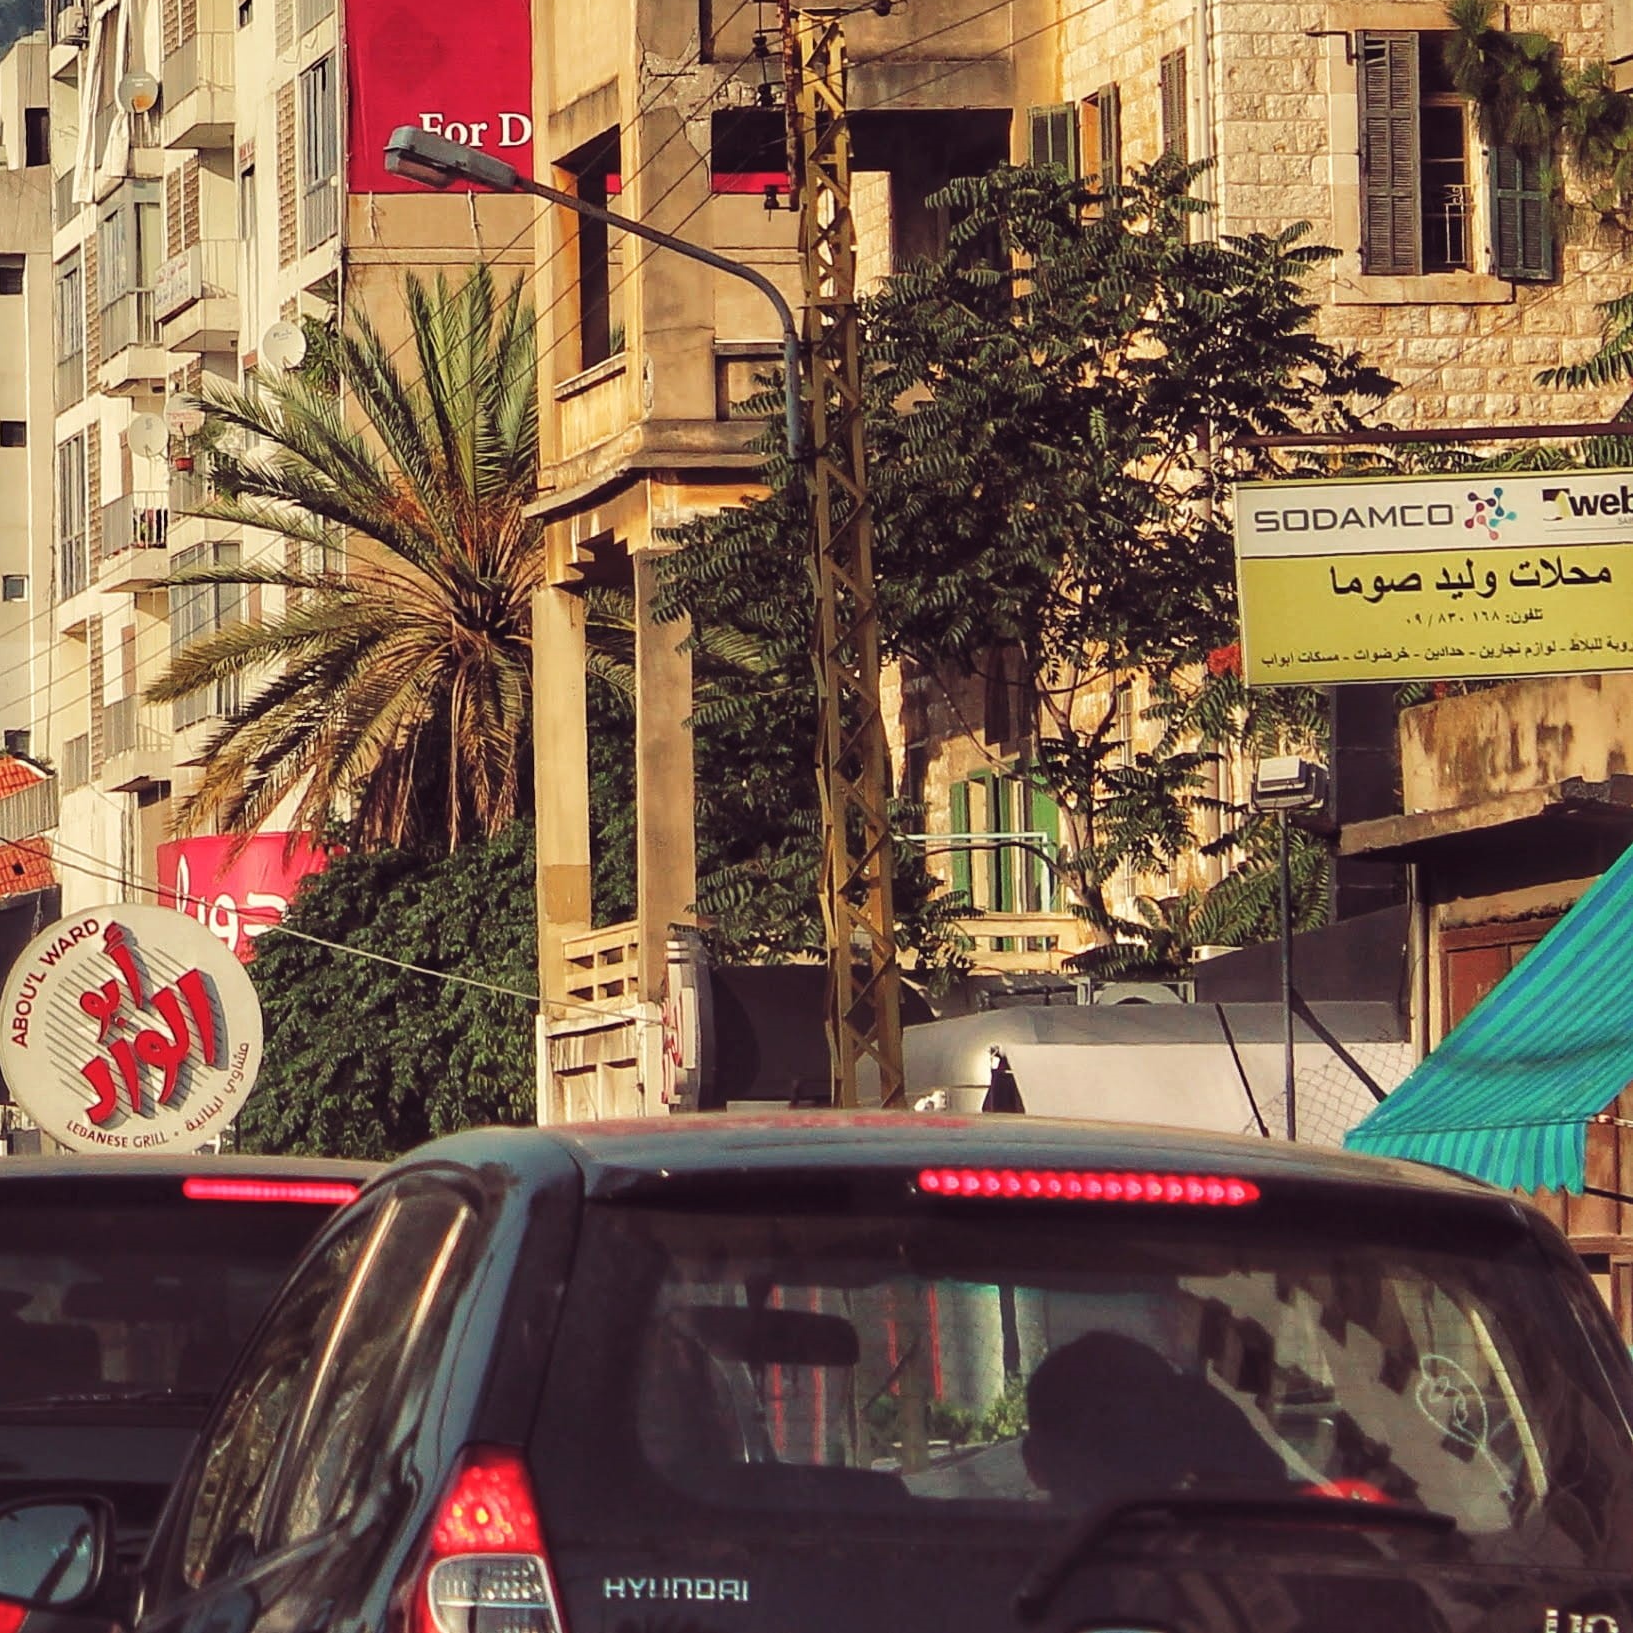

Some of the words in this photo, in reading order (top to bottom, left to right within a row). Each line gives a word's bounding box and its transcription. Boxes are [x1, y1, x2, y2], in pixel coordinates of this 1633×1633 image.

[418, 112, 488, 147] For
[1253, 502, 1455, 534] SODAMCO
[1329, 565, 1423, 604] صوما
[1435, 557, 1498, 600] وليد
[1508, 554, 1613, 589] محلات
[1478, 641, 1522, 660] نجارين
[1524, 639, 1557, 659] لوازم
[10, 971, 48, 1050] ABOU'L
[38, 917, 100, 968] WARD
[65, 1119, 129, 1148] LEBANESE
[132, 1131, 169, 1148] GRILL
[602, 1576, 750, 1601] HYUNDAI
